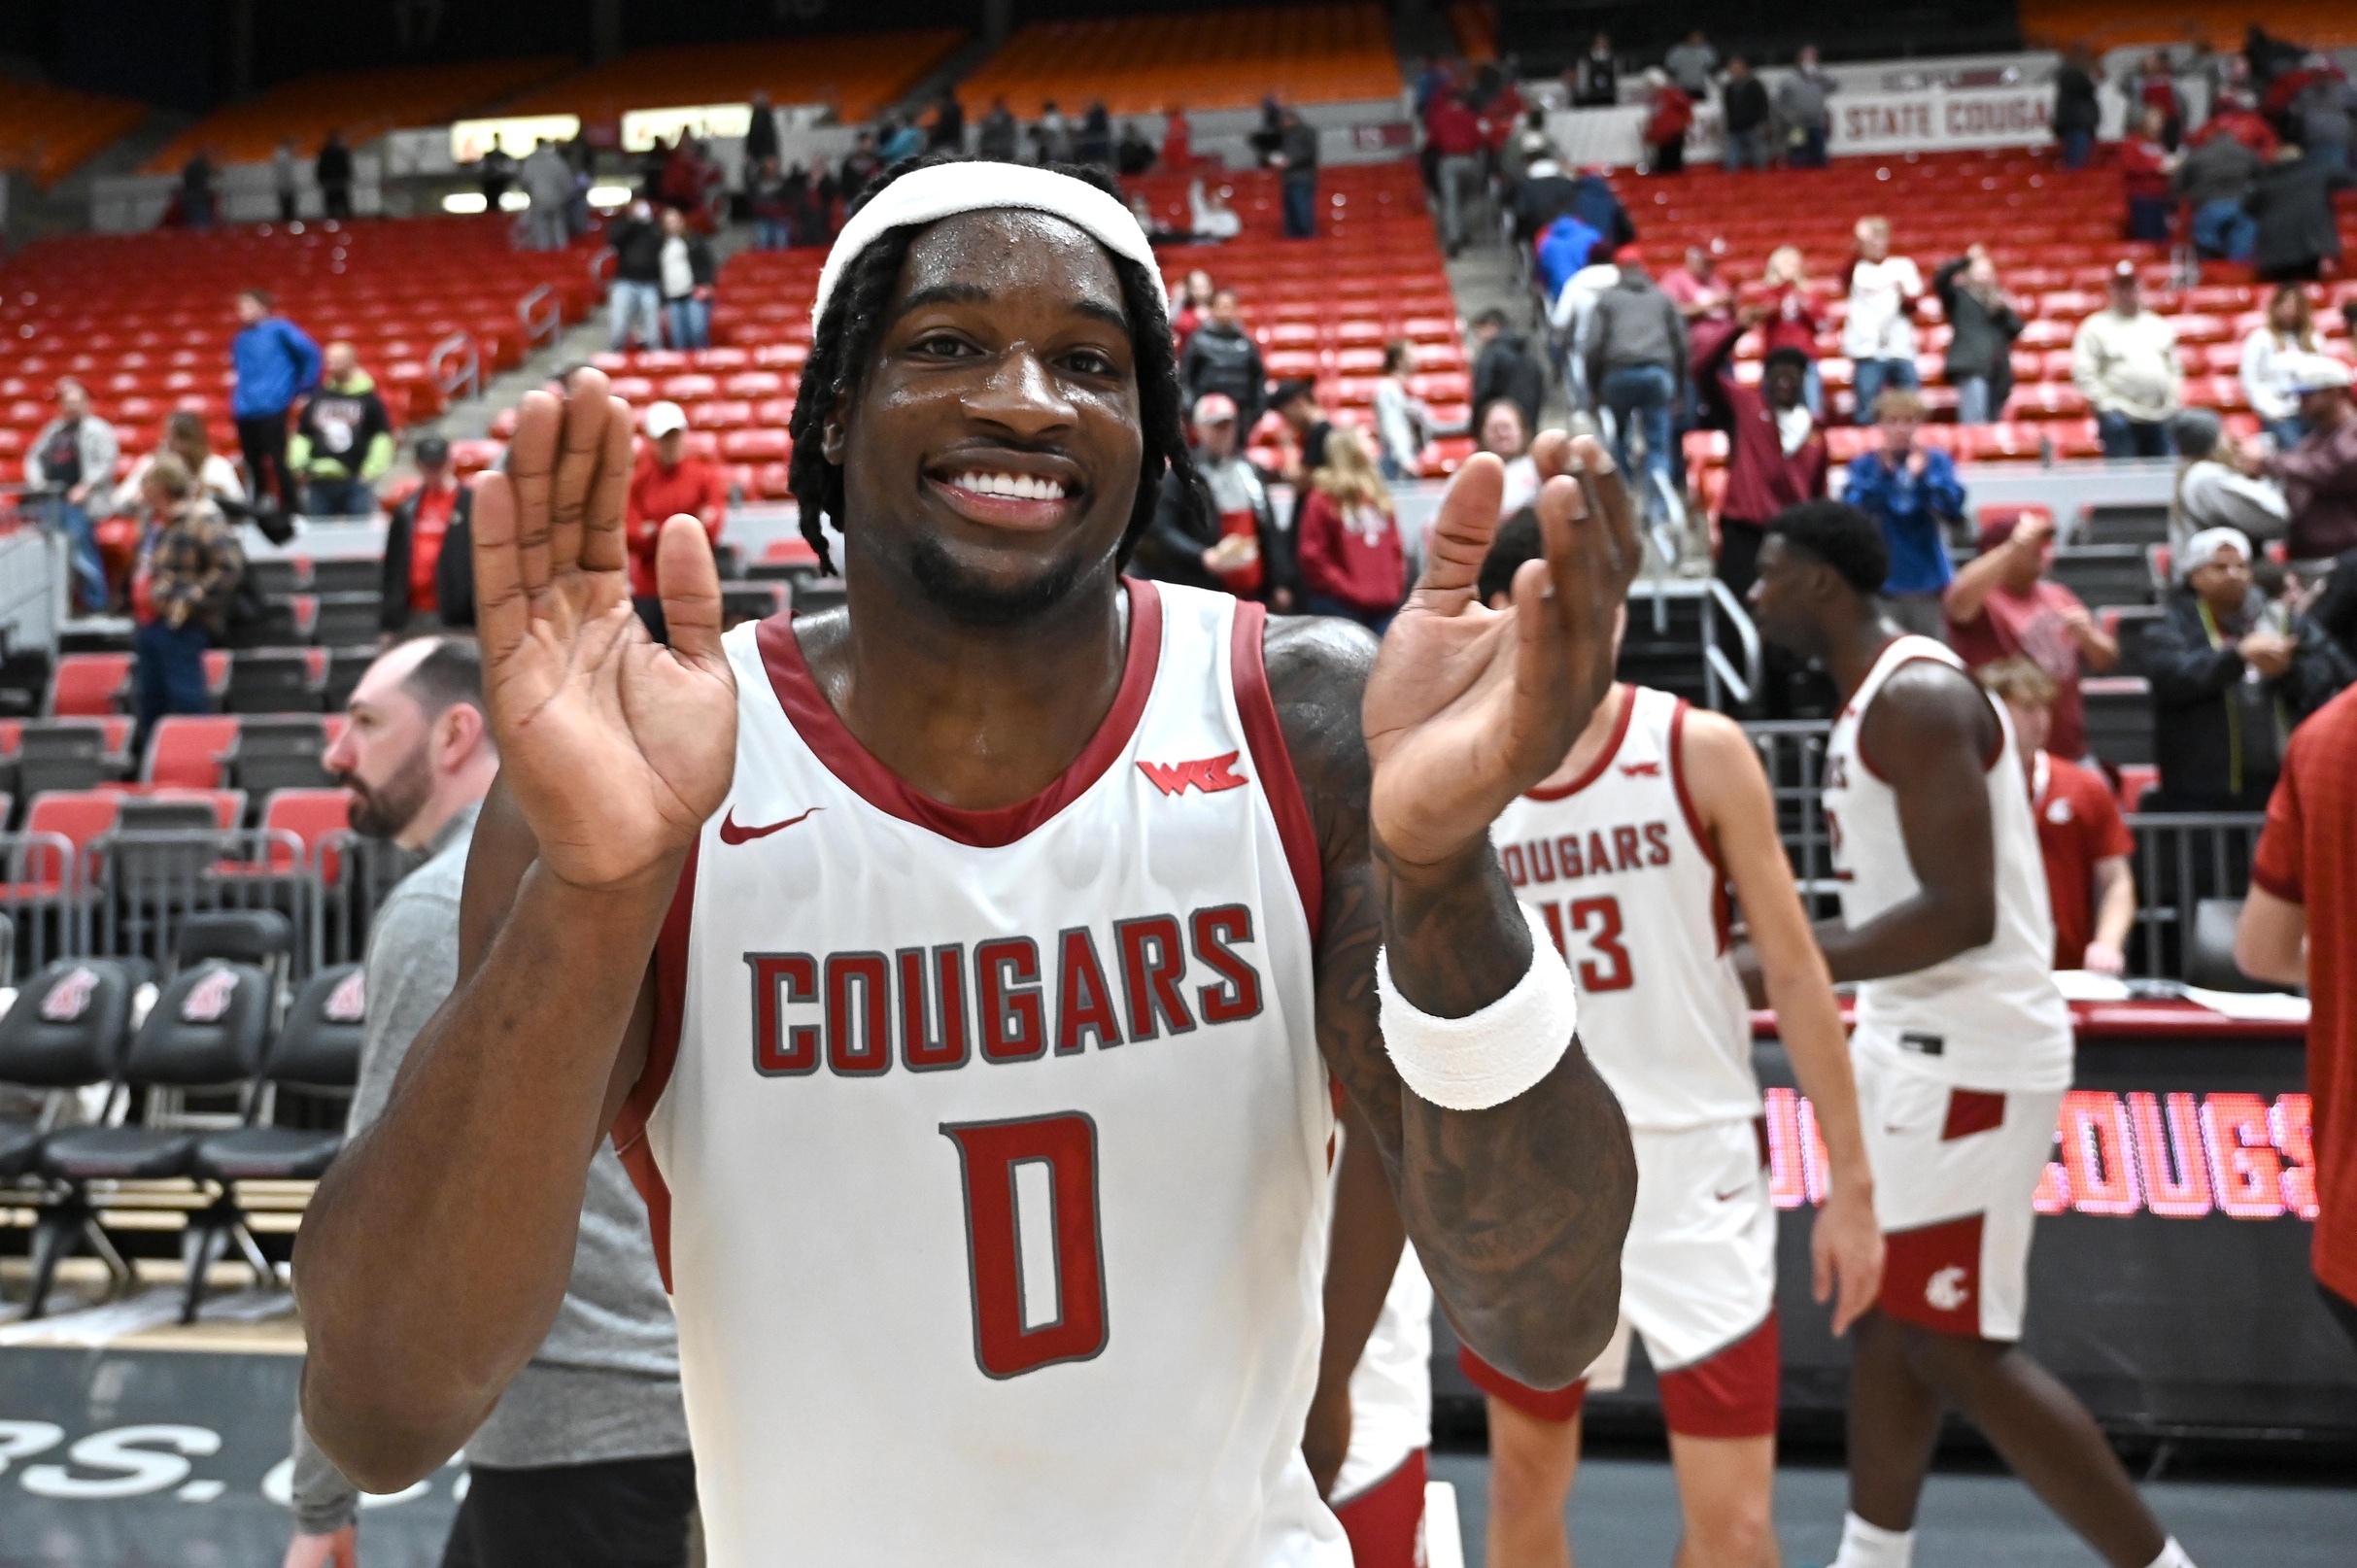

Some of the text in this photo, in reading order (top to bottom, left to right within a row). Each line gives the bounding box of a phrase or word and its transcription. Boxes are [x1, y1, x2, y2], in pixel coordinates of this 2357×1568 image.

[1846, 103, 1931, 142] STATE
[1946, 97, 2050, 136] COUGA
[1502, 821, 1671, 888] OUGARS
[743, 903, 1264, 1077] COUGARS
[939, 1109, 1110, 1381] 0
